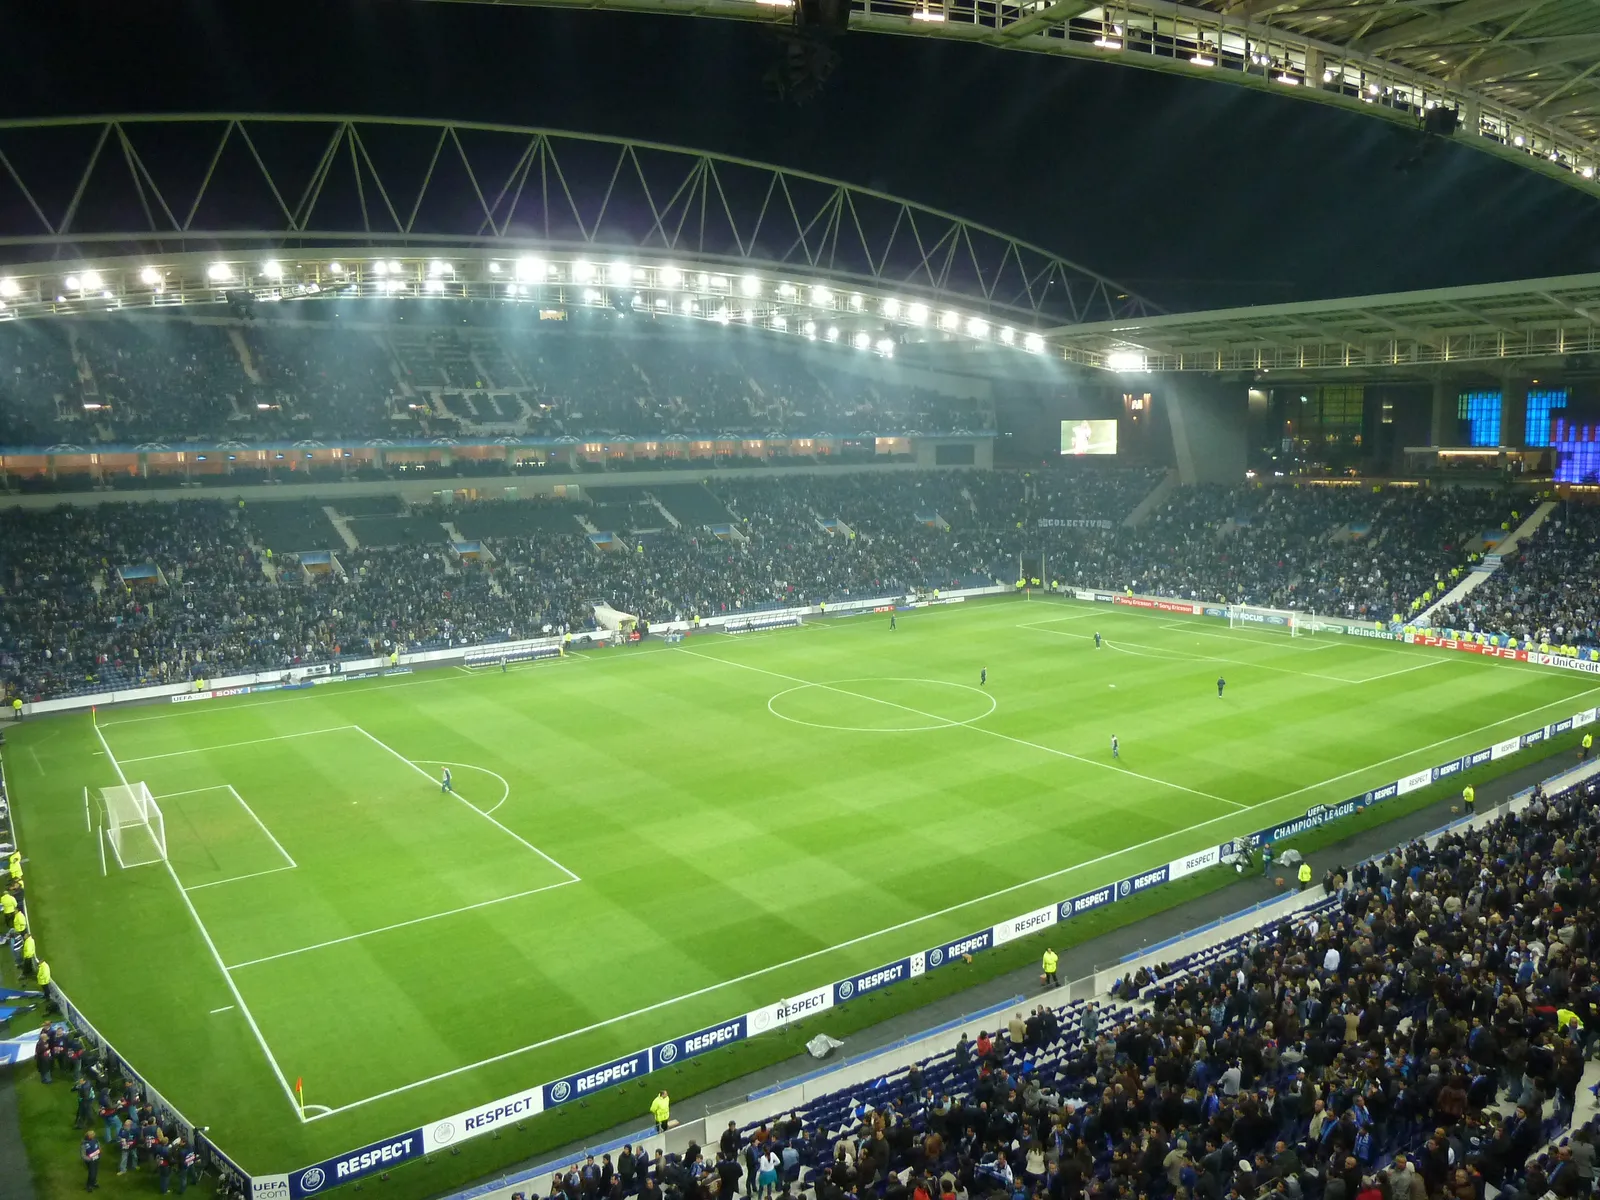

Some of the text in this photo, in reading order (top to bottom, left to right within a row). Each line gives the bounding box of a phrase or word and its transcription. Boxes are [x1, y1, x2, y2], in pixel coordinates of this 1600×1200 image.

[1347, 625, 1393, 639] Heineken
[1425, 636, 1458, 649] PS3
[1482, 645, 1516, 659] PS3
[1552, 656, 1599, 673] UniCredit
[216, 688, 244, 697] SONY
[1409, 774, 1428, 787] RESPECT
[1374, 785, 1396, 800] RESPECT
[1273, 802, 1354, 840] CHAMPIONS LEAGUE
[1186, 852, 1215, 869] RESPECT
[1134, 869, 1166, 889] RESPECT
[1075, 890, 1109, 911] RESPECT
[1015, 911, 1051, 933] RESPECT
[948, 934, 988, 958] RESPECT
[858, 965, 903, 991] RESPECT
[776, 993, 826, 1020] RESPECT
[685, 1023, 740, 1053] RESPECT
[577, 1059, 639, 1092] RESPECT
[465, 1097, 532, 1131] RESPECT
[336, 1138, 413, 1178] RESPECT
[253, 1181, 288, 1191] UEFA
